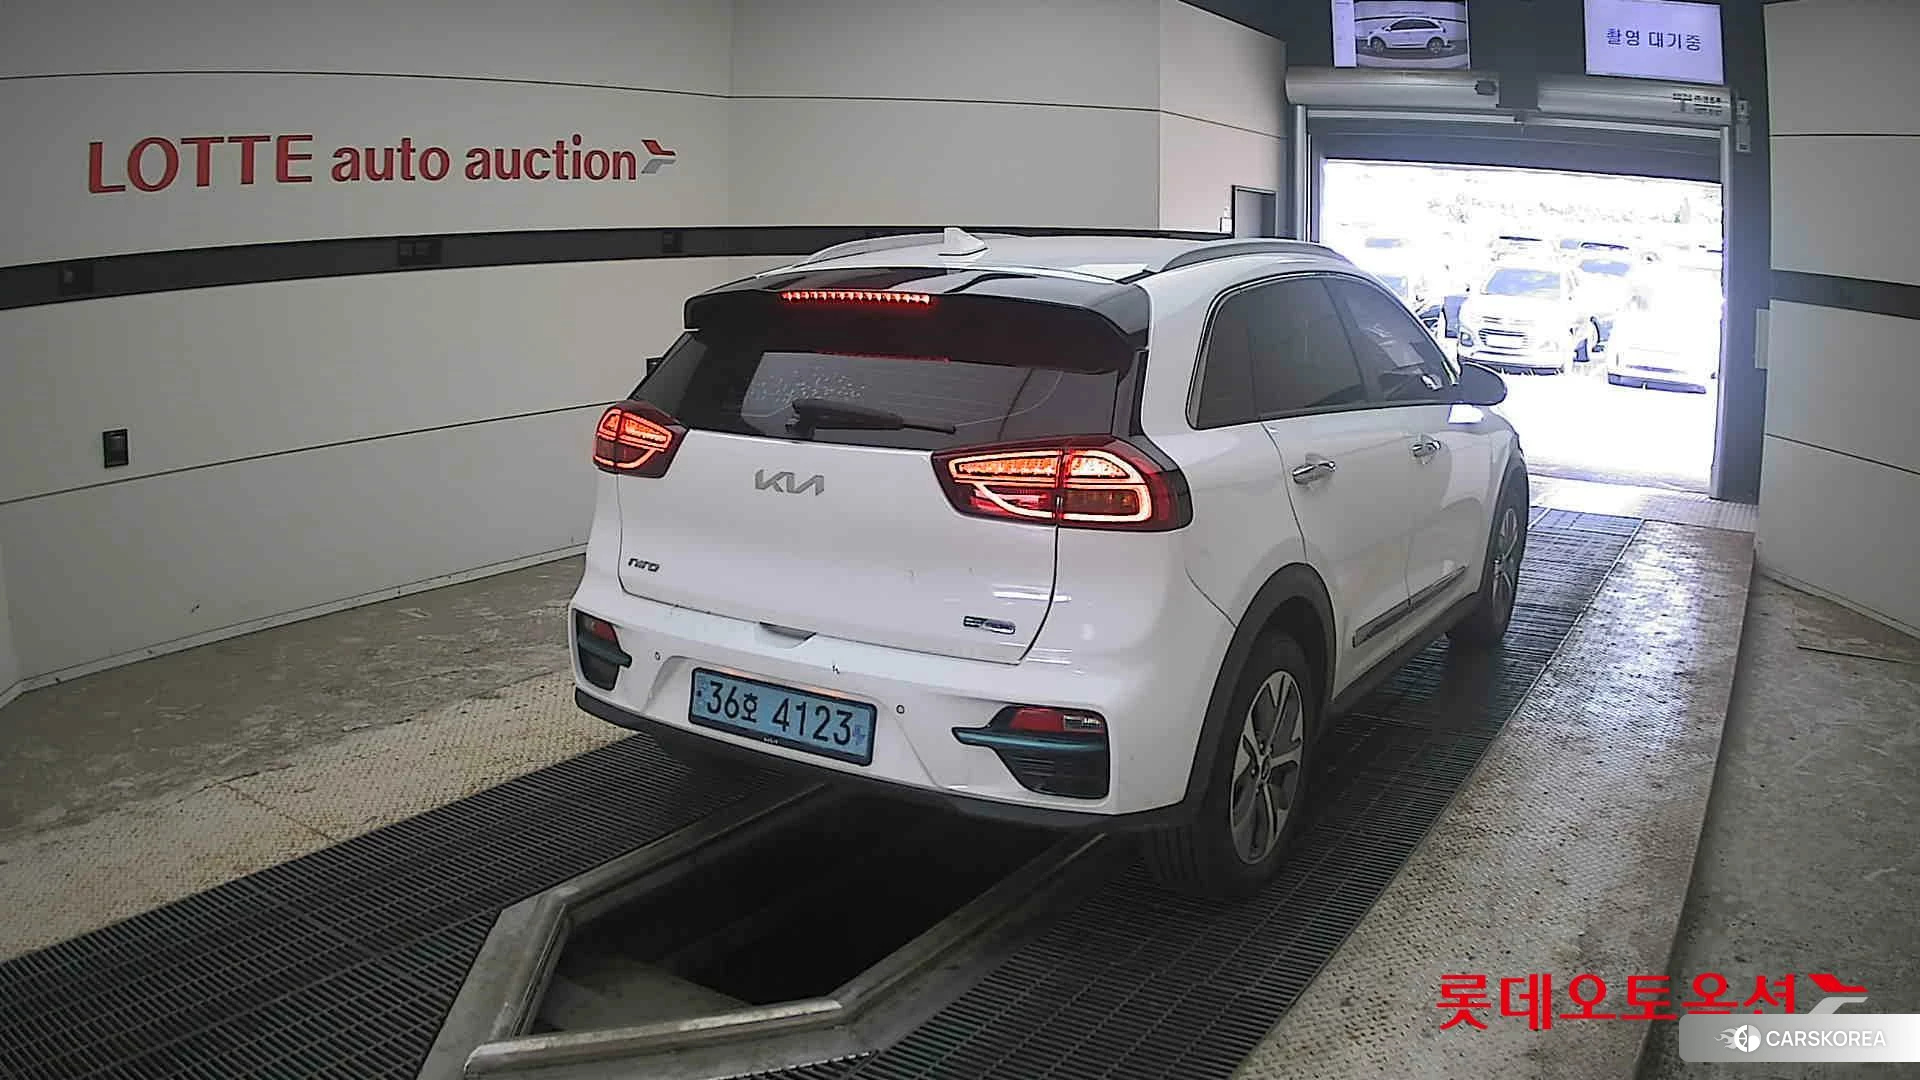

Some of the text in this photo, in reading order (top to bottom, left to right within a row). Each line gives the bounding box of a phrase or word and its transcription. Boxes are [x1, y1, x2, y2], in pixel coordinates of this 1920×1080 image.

[1607, 27, 1701, 52] 촬영 대기중
[89, 133, 637, 194] LOTTE auto auction
[706, 680, 853, 746] 36호 4123
